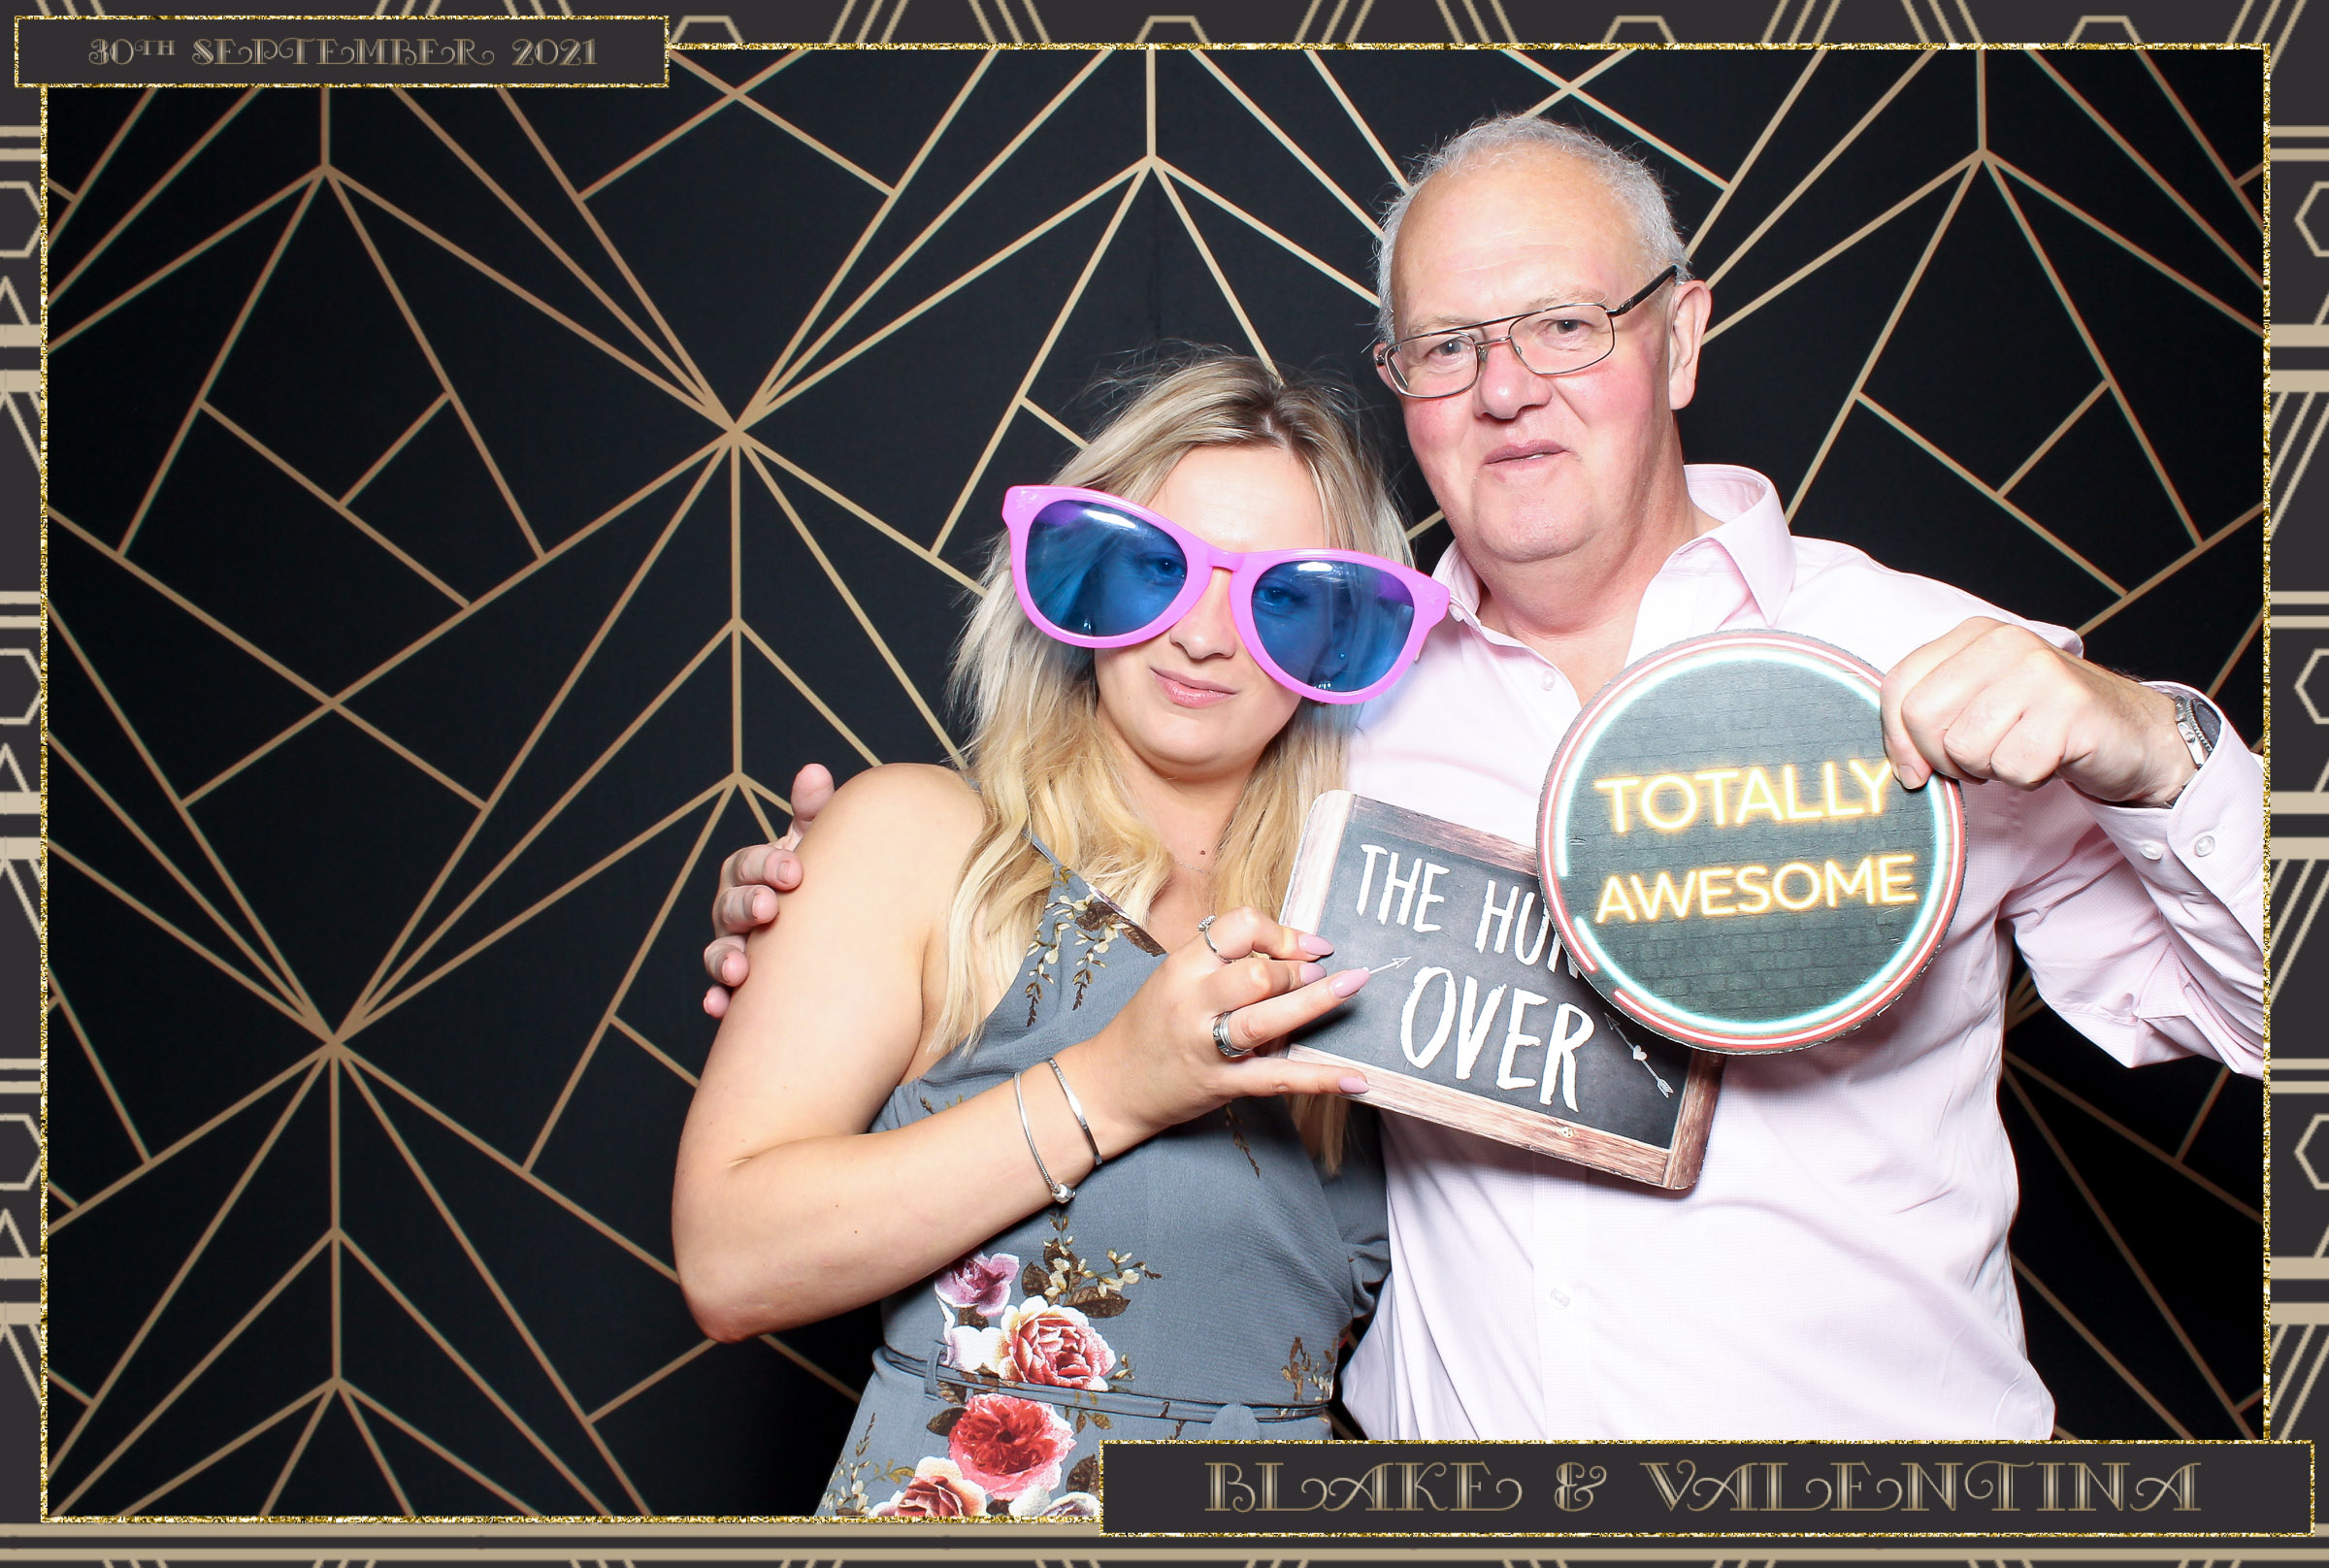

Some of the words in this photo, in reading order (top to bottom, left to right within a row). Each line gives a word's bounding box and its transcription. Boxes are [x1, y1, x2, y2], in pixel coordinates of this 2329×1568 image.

[1595, 760, 1893, 833] TOTALLY
[1355, 844, 1450, 933] THE
[1594, 854, 1919, 925] AWESOME
[1400, 966, 1595, 1112] OVER
